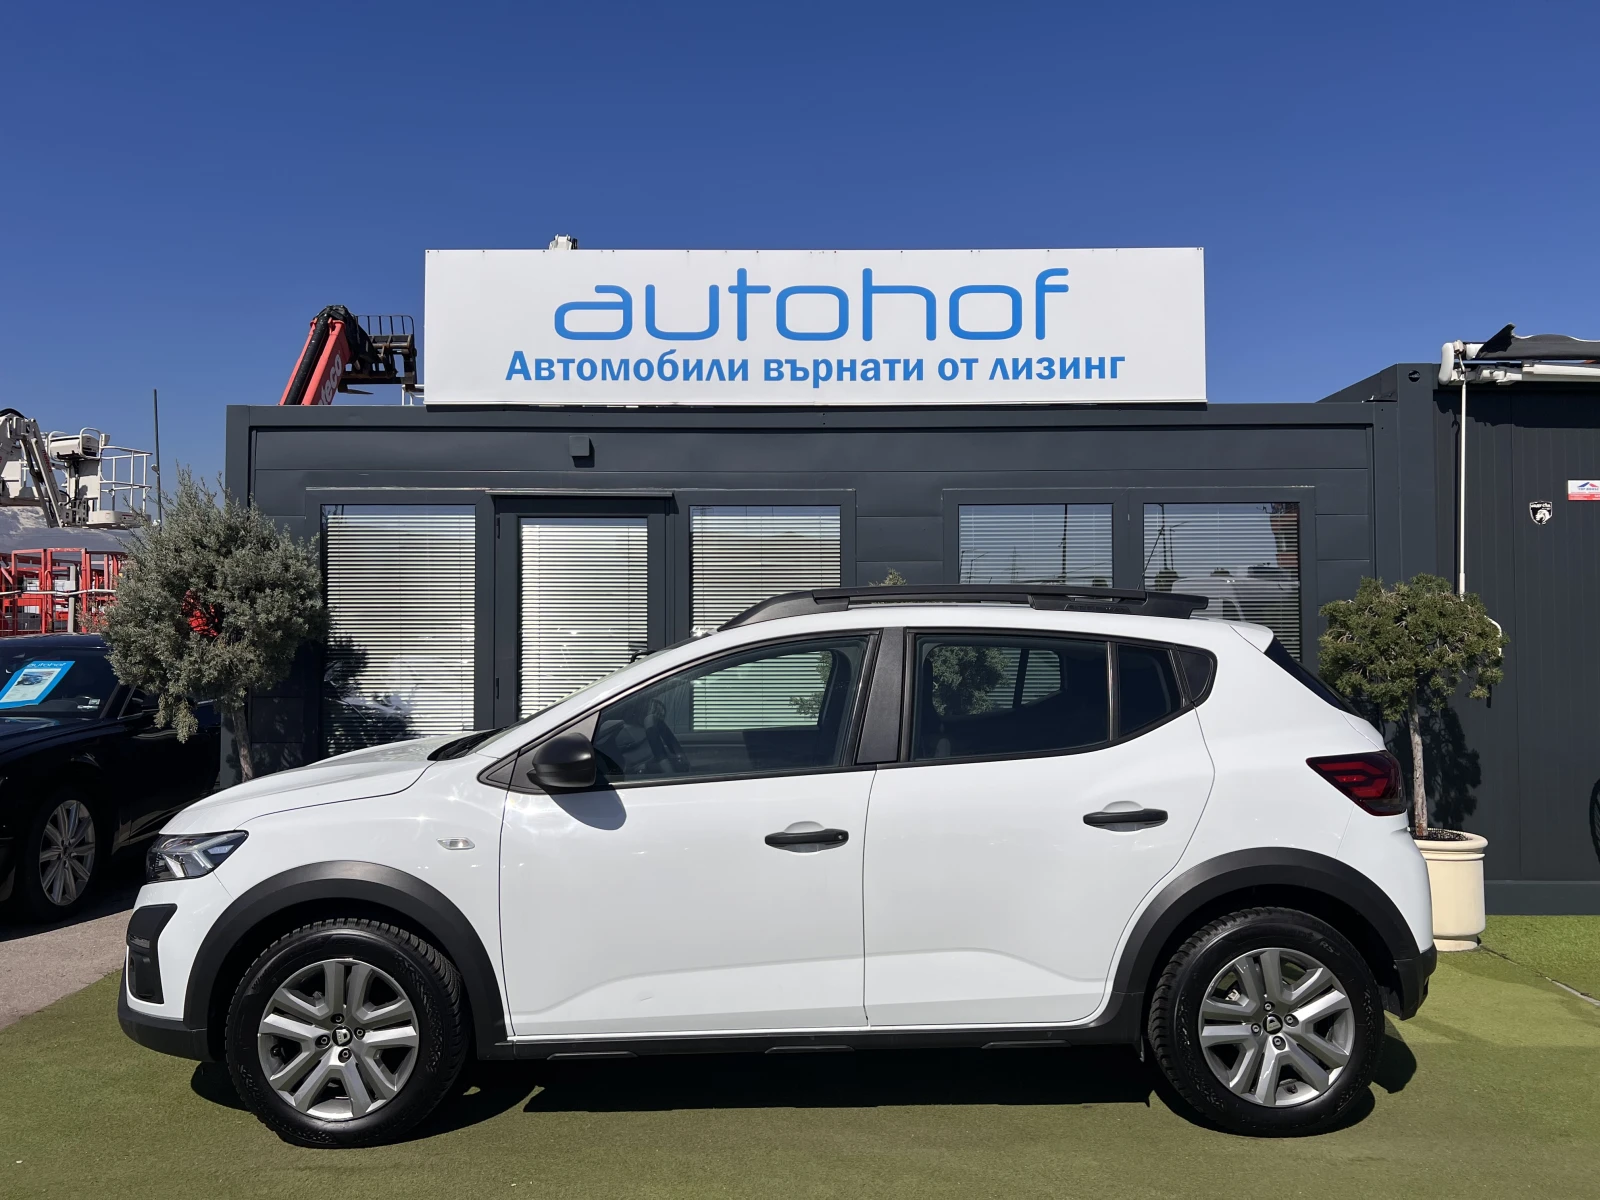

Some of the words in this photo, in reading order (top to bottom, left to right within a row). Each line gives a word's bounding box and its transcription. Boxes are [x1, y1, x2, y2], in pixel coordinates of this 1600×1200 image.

[554, 267, 1070, 342] autohof
[505, 349, 749, 382] Автомобили
[764, 357, 924, 389] върнати
[938, 357, 979, 382] от
[989, 355, 1126, 382] лизинг
